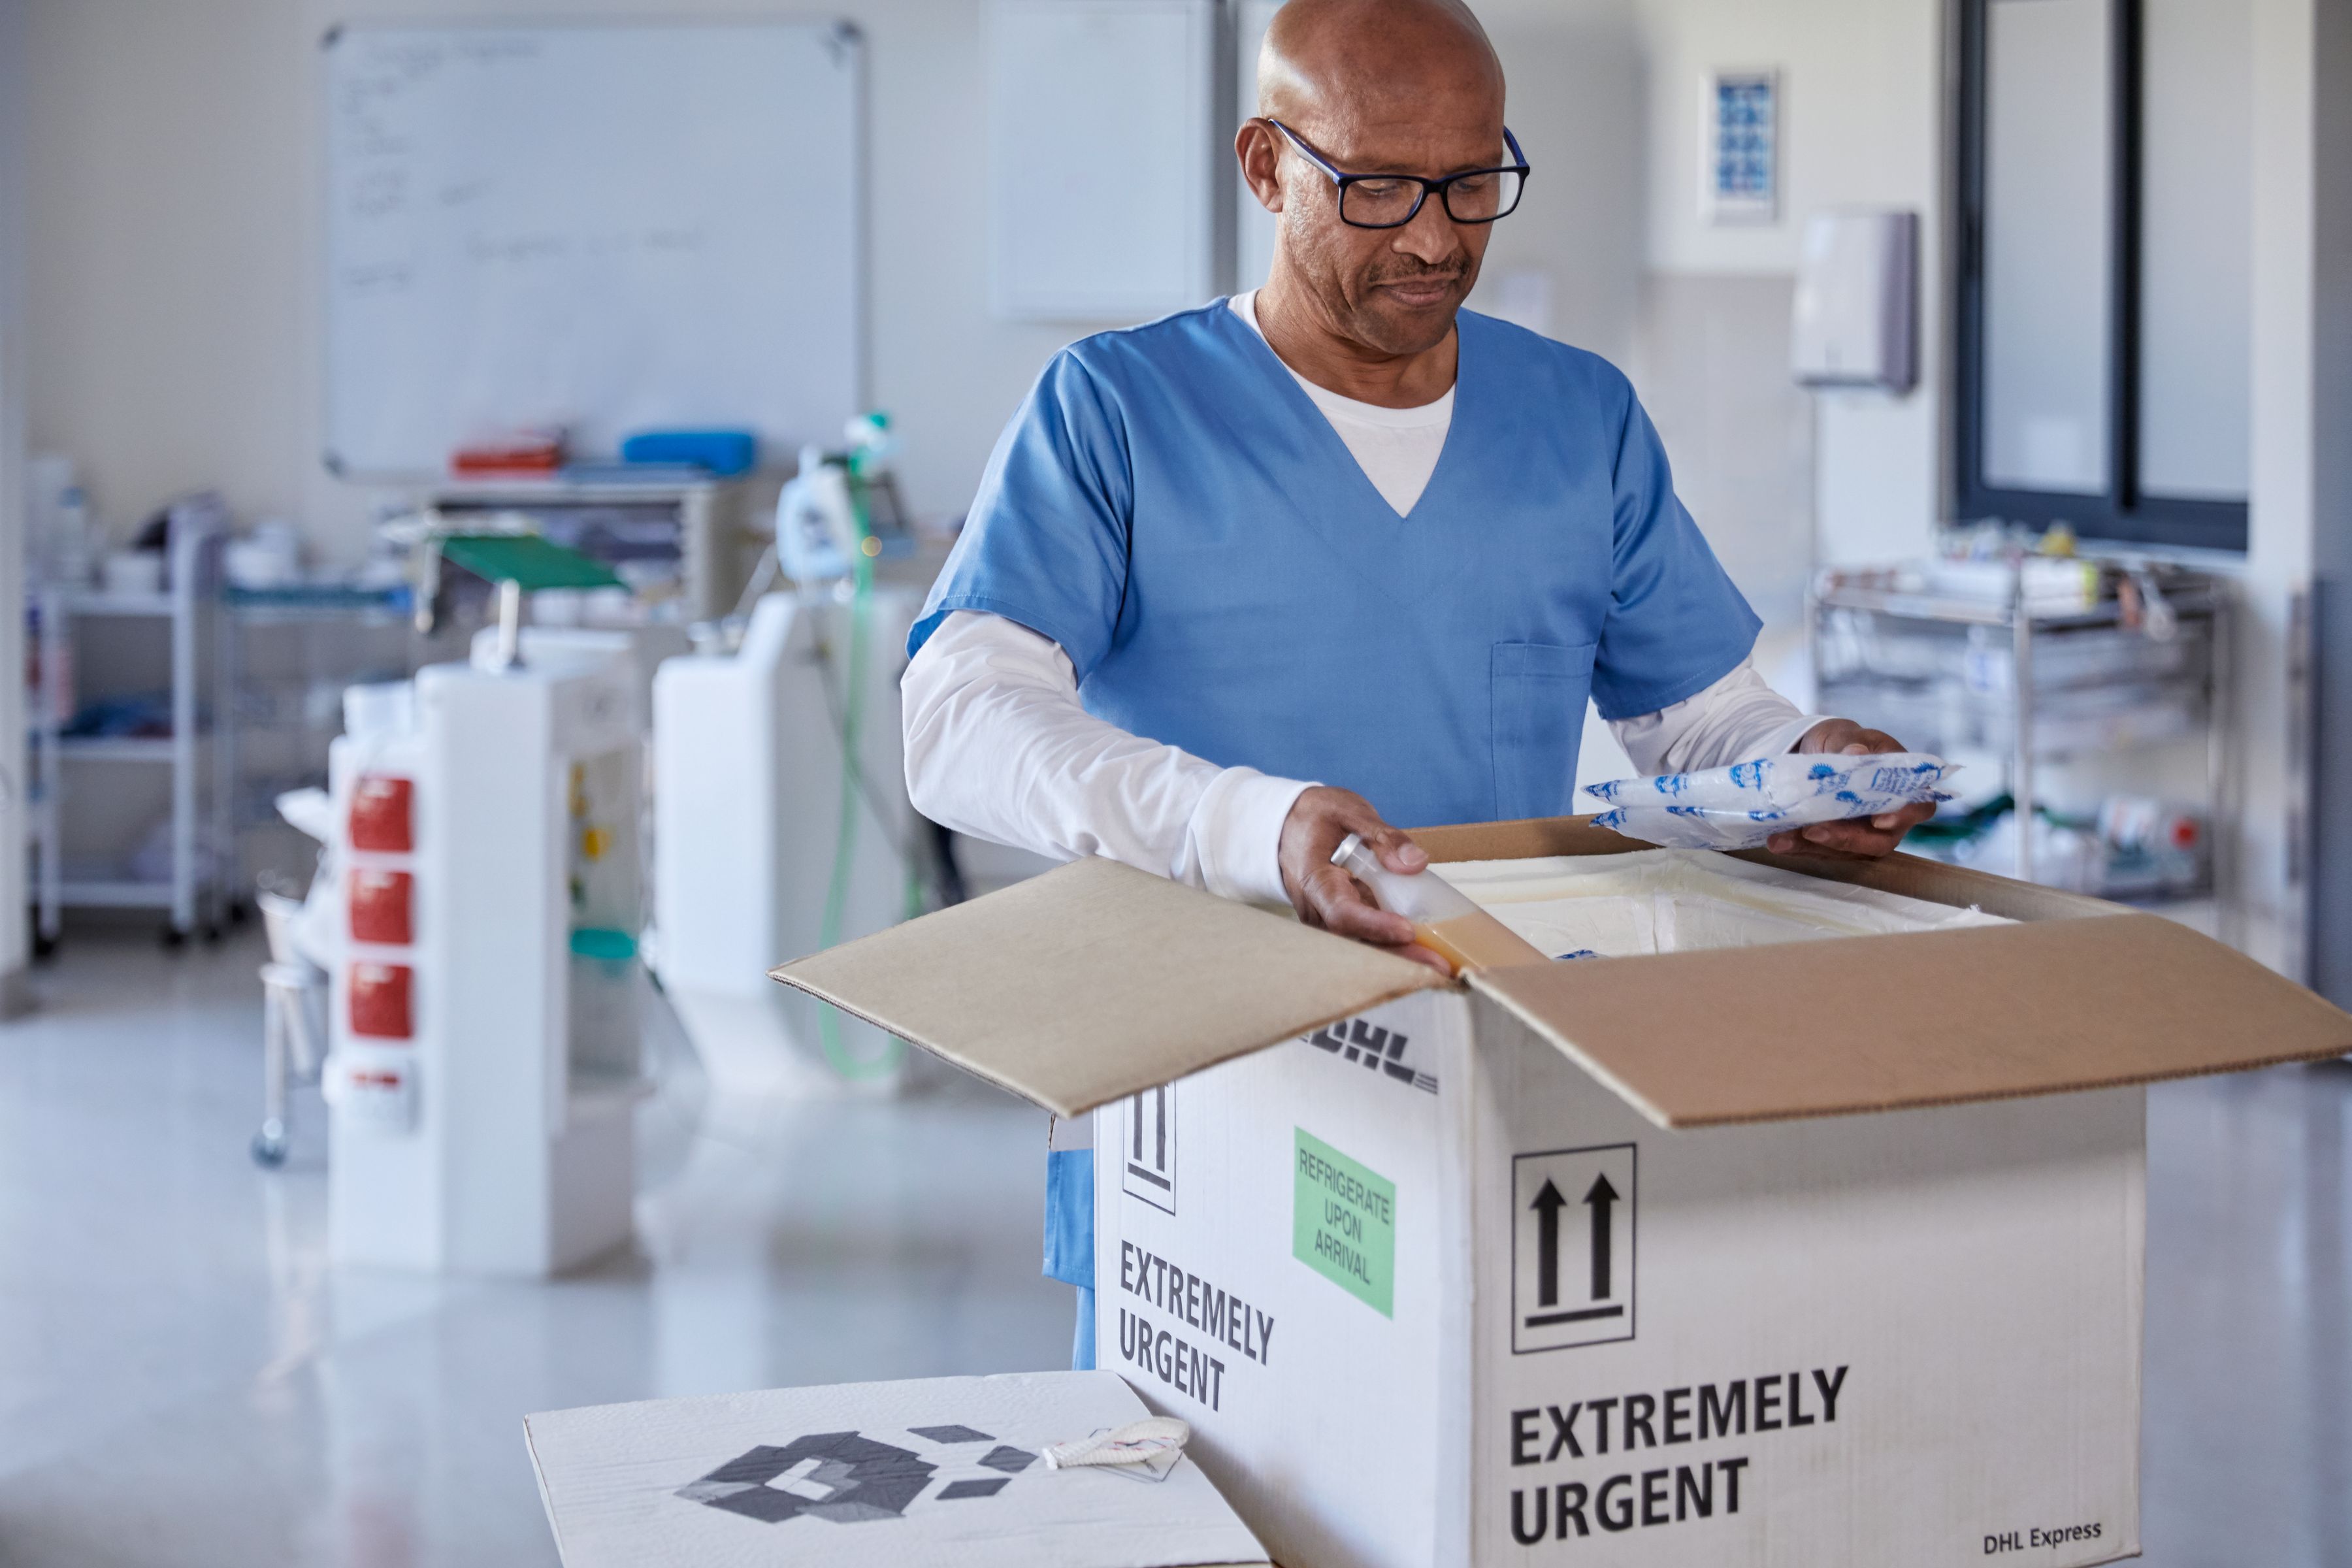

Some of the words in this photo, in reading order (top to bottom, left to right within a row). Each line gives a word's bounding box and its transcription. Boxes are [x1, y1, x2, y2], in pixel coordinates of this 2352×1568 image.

[1310, 1018, 1415, 1086] DHL
[1299, 1147, 1390, 1226] REFRIGERATE
[1325, 1198, 1362, 1243] UPON
[1315, 1228, 1371, 1285] ARRIVAL
[1120, 1239, 1274, 1367] EXTREMELY
[1120, 1307, 1225, 1413] URGENT
[1511, 1365, 1848, 1466] EXTREMELY
[1511, 1456, 1748, 1546] URGENT
[1984, 1531, 2024, 1555] DHL
[2030, 1522, 2102, 1549] Express
